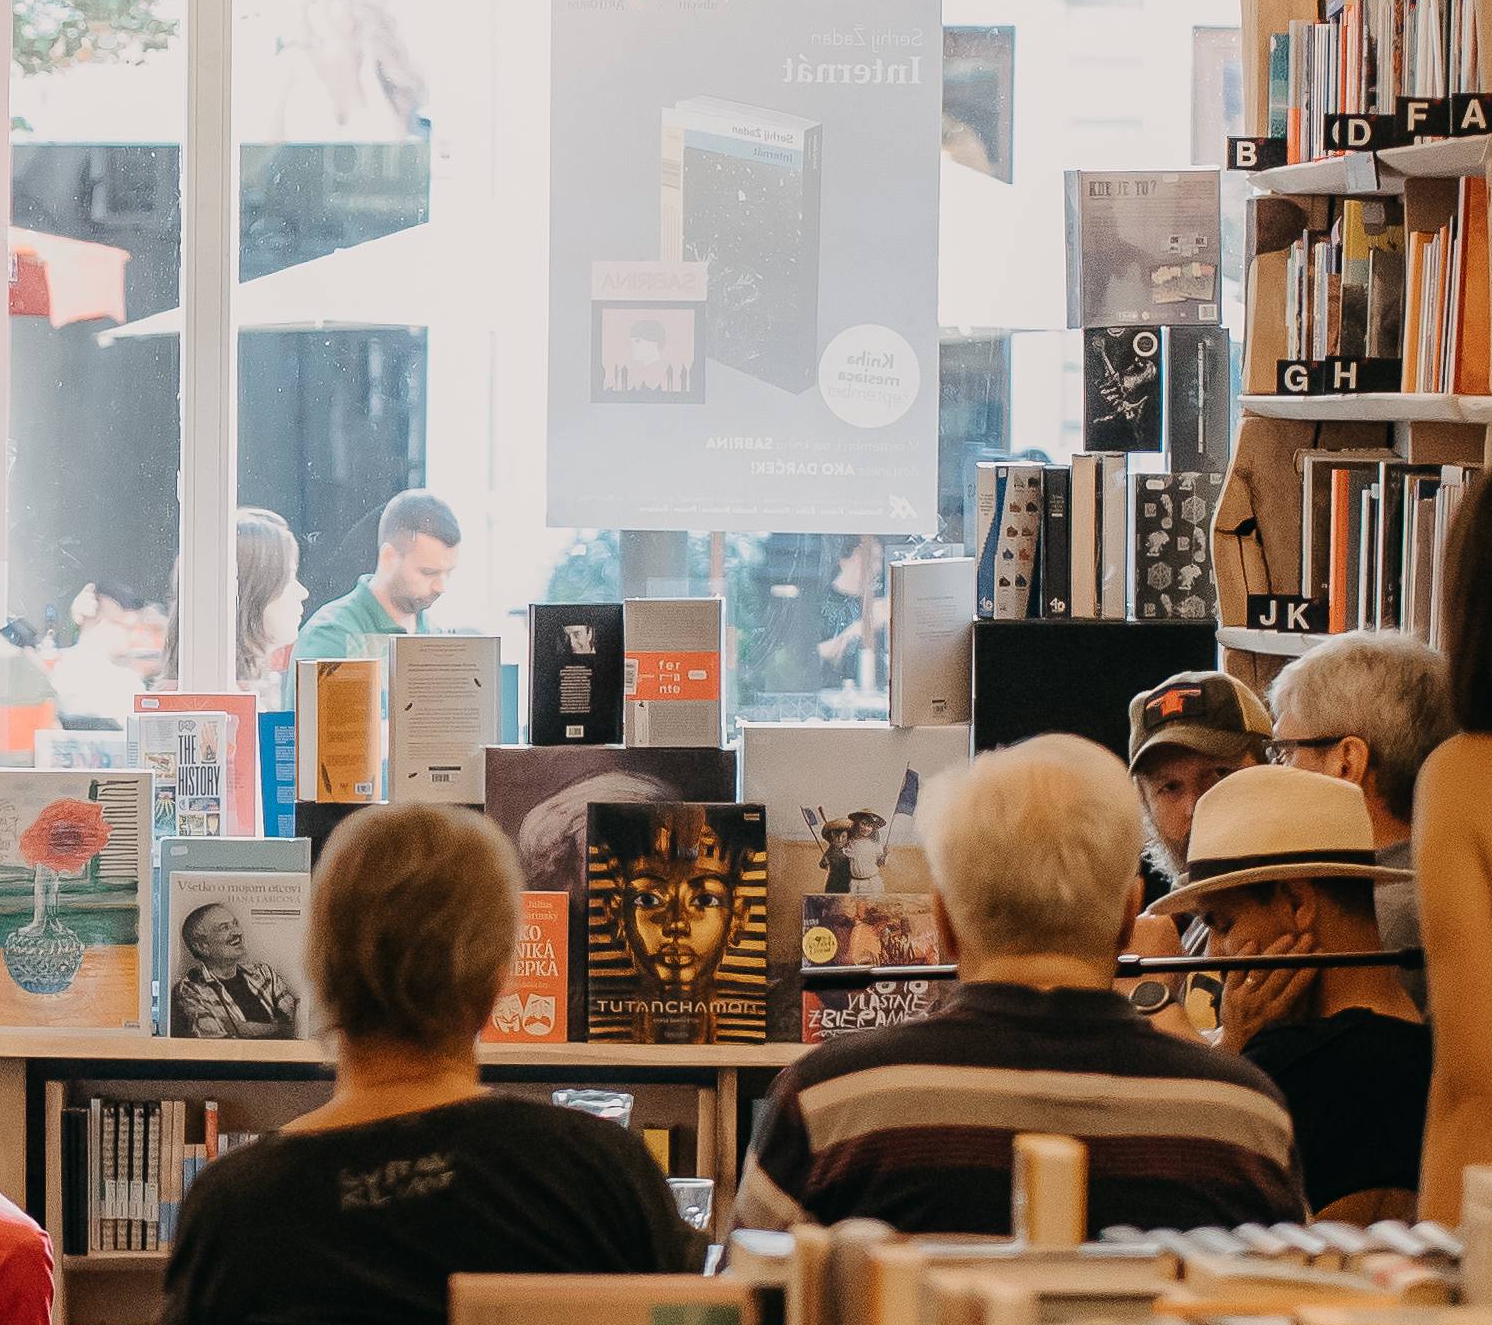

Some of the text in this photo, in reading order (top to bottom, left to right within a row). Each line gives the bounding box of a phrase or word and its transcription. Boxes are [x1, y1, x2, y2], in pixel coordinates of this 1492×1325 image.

[1407, 102, 1429, 132] F
[1461, 98, 1487, 129] A
[1347, 119, 1372, 146] D
[1235, 142, 1258, 168] B
[1284, 364, 1309, 392] G
[1333, 361, 1357, 389] H
[1259, 597, 1280, 626] J
[1286, 601, 1310, 632] K
[178, 734, 197, 766] THE
[177, 765, 221, 797] HISTORY
